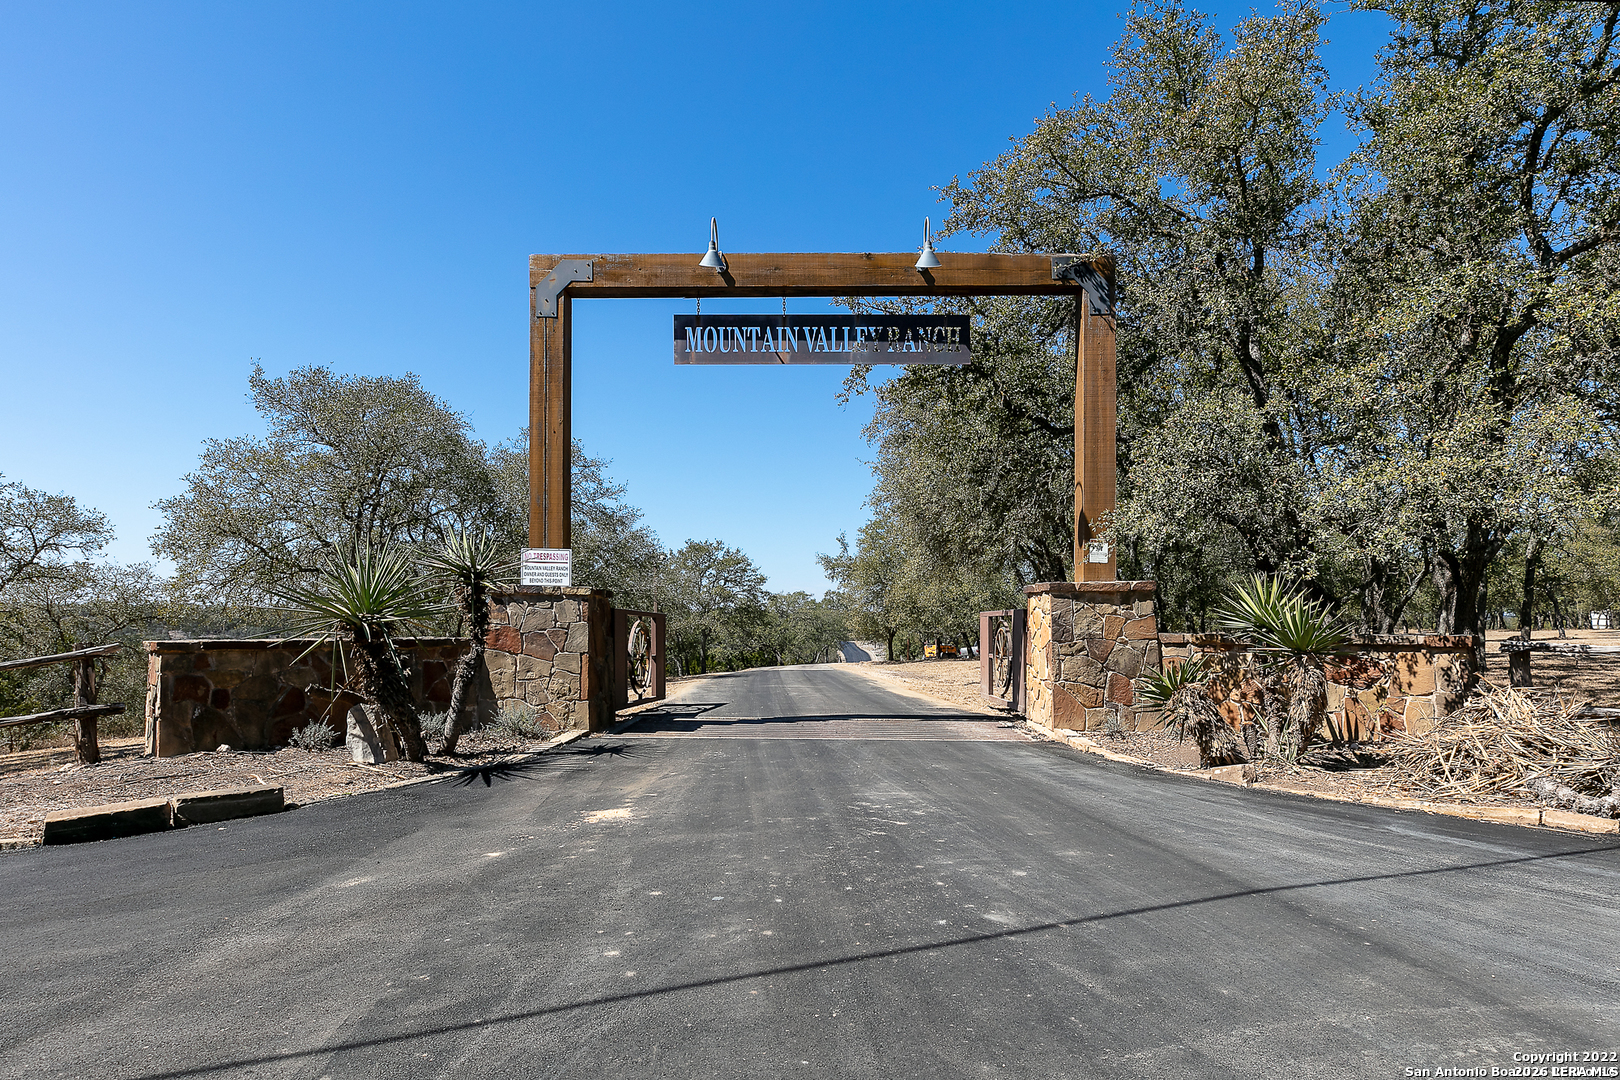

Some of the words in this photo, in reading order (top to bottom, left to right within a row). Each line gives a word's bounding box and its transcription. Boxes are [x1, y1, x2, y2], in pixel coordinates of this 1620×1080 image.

[684, 326, 799, 353] MOUNTAIN
[802, 326, 883, 353] VALLEY
[886, 326, 962, 353] RANCH
[524, 552, 532, 560] NO
[533, 552, 568, 561] TRESPASSING
